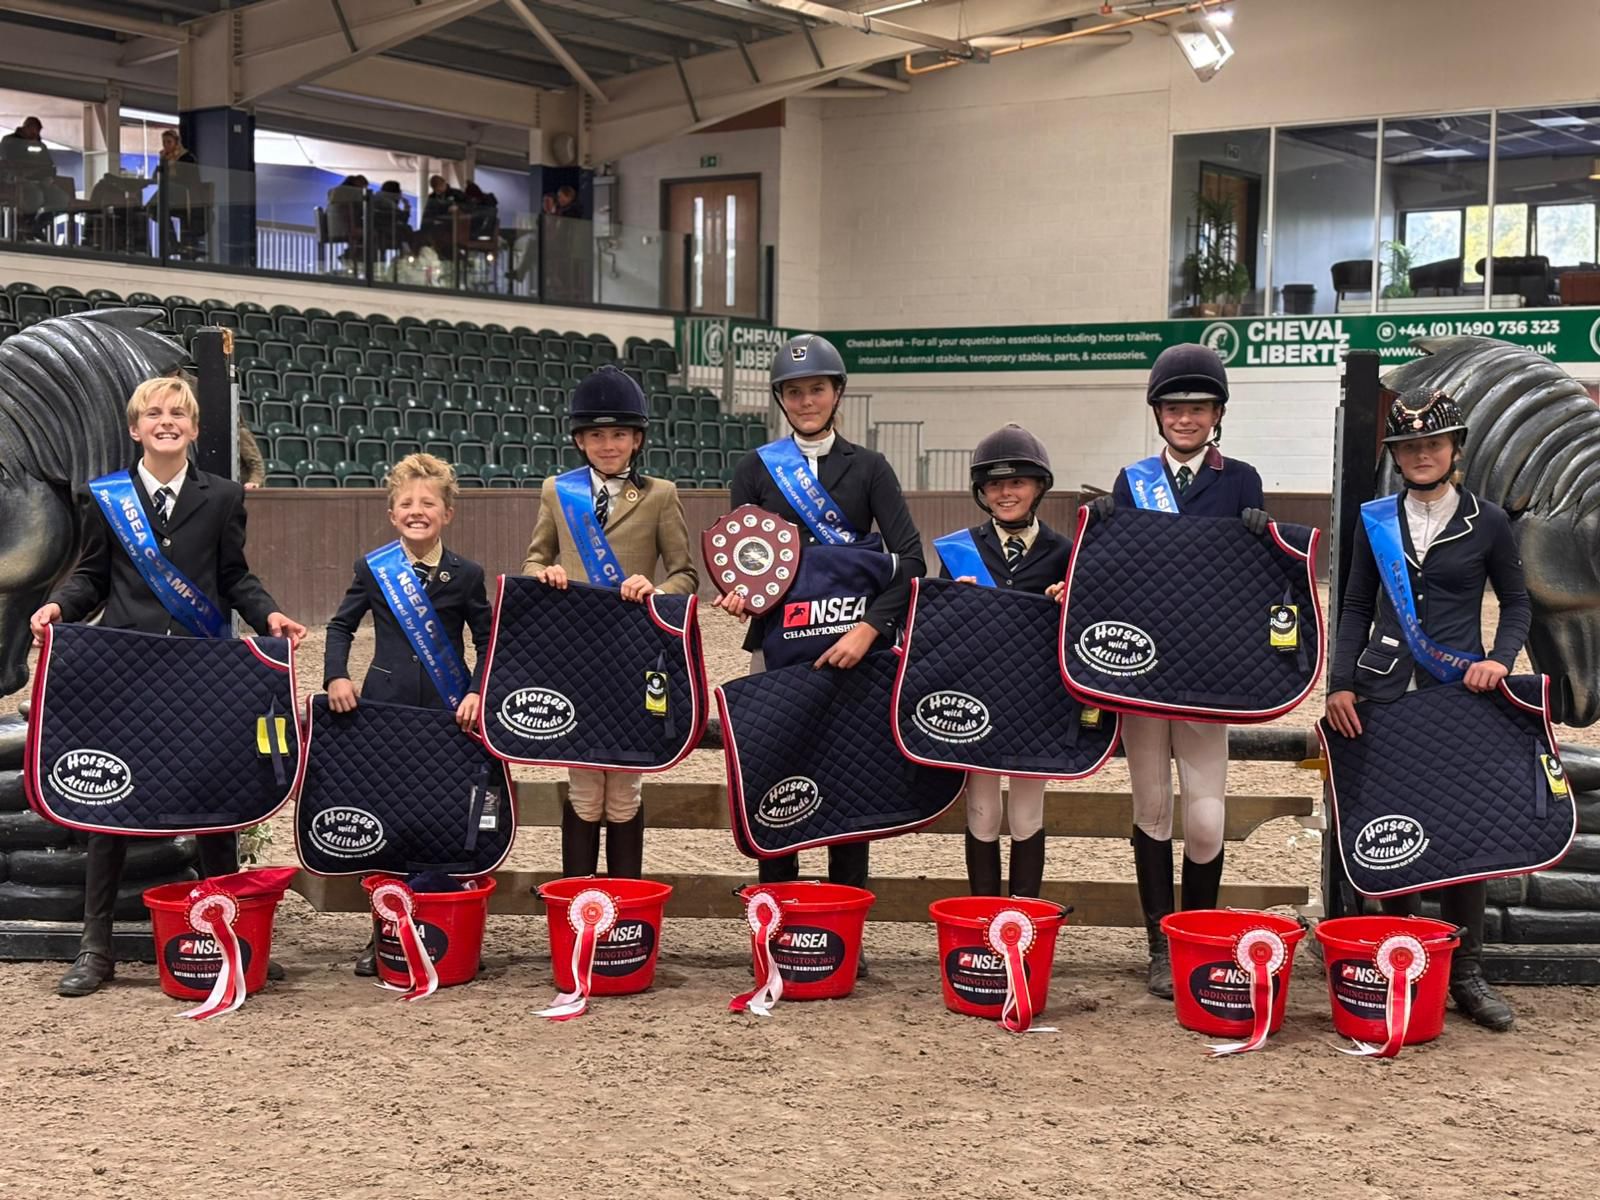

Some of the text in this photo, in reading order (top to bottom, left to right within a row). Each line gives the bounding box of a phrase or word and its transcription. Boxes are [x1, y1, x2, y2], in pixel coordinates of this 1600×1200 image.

[1247, 320, 1350, 342] CHEVAL
[1398, 319, 1560, 337] +44 (0) 1490 736 323
[846, 338, 874, 348] Cheval
[874, 337, 904, 348] Liberté
[911, 338, 925, 347] For
[926, 337, 938, 347] all
[938, 338, 958, 348] your
[959, 335, 1006, 347] equestrian
[1007, 334, 1052, 345] essentials
[1053, 332, 1097, 344] including
[1098, 332, 1126, 343] horse
[1127, 331, 1163, 343] trailers,
[858, 350, 1148, 365] internal & external stables, temporary stables, parts, & accessories.
[1246, 339, 1350, 364] LIBERTÉ
[775, 465, 808, 512] Sponsored
[806, 511, 817, 523] by
[793, 466, 826, 511] NSEA
[119, 494, 148, 546] NSEA
[397, 570, 429, 619] NSEA
[809, 596, 867, 625] NSEA
[405, 616, 417, 631] by
[413, 629, 437, 667] Horses
[1094, 624, 1148, 647] Horses
[1090, 645, 1143, 664] Attitude
[515, 691, 567, 710] Horses
[929, 695, 981, 714] Horses
[512, 712, 563, 728] Attitude
[927, 715, 978, 731] Attitude
[67, 753, 122, 774] Horses
[63, 775, 118, 793] Attitude
[769, 781, 810, 803] Horses
[767, 796, 810, 817] Attitude
[324, 811, 375, 829] Horses
[321, 831, 372, 847] Attitude
[1365, 820, 1414, 842] Horses
[1365, 838, 1414, 858] Attitude
[607, 924, 643, 942] NSEA
[791, 933, 828, 948] NSEA
